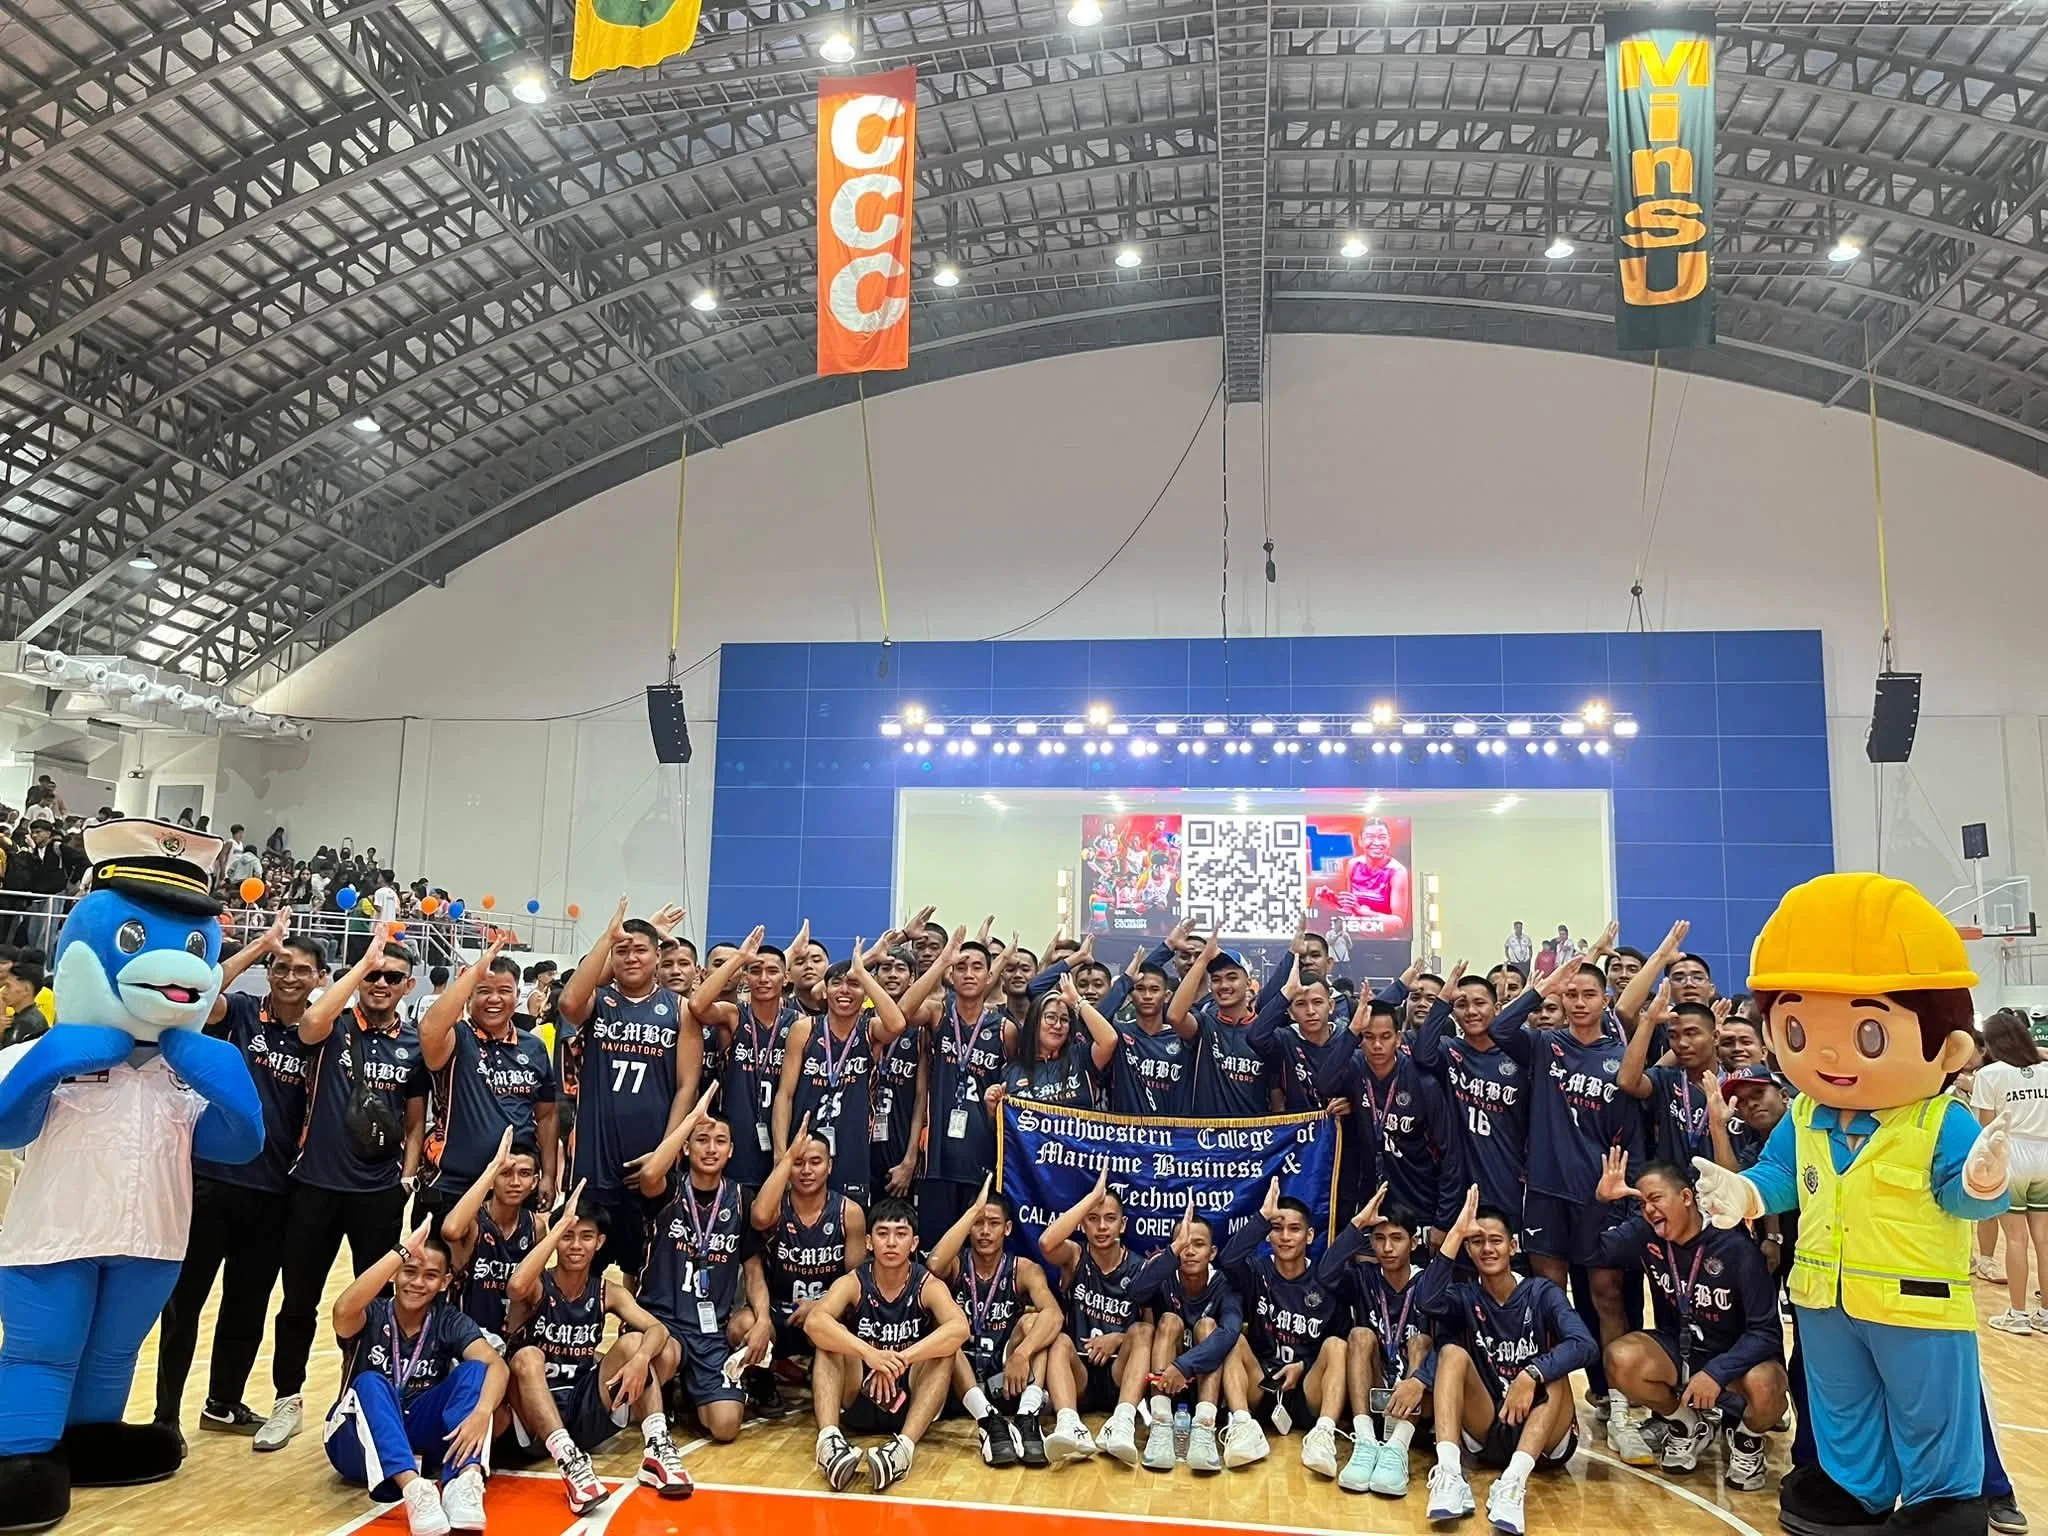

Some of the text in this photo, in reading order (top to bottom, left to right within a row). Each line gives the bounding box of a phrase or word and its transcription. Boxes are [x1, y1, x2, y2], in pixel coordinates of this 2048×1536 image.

[829, 94, 907, 333] CCC
[593, 1017, 677, 1048] SCMBT
[601, 1042, 664, 1057] NAVIGATORS
[612, 1060, 647, 1094] 77
[1017, 1109, 1316, 1151] Southwestern College of
[1035, 1141, 1302, 1179] Maritime Business &
[1108, 1182, 1234, 1212] Technology
